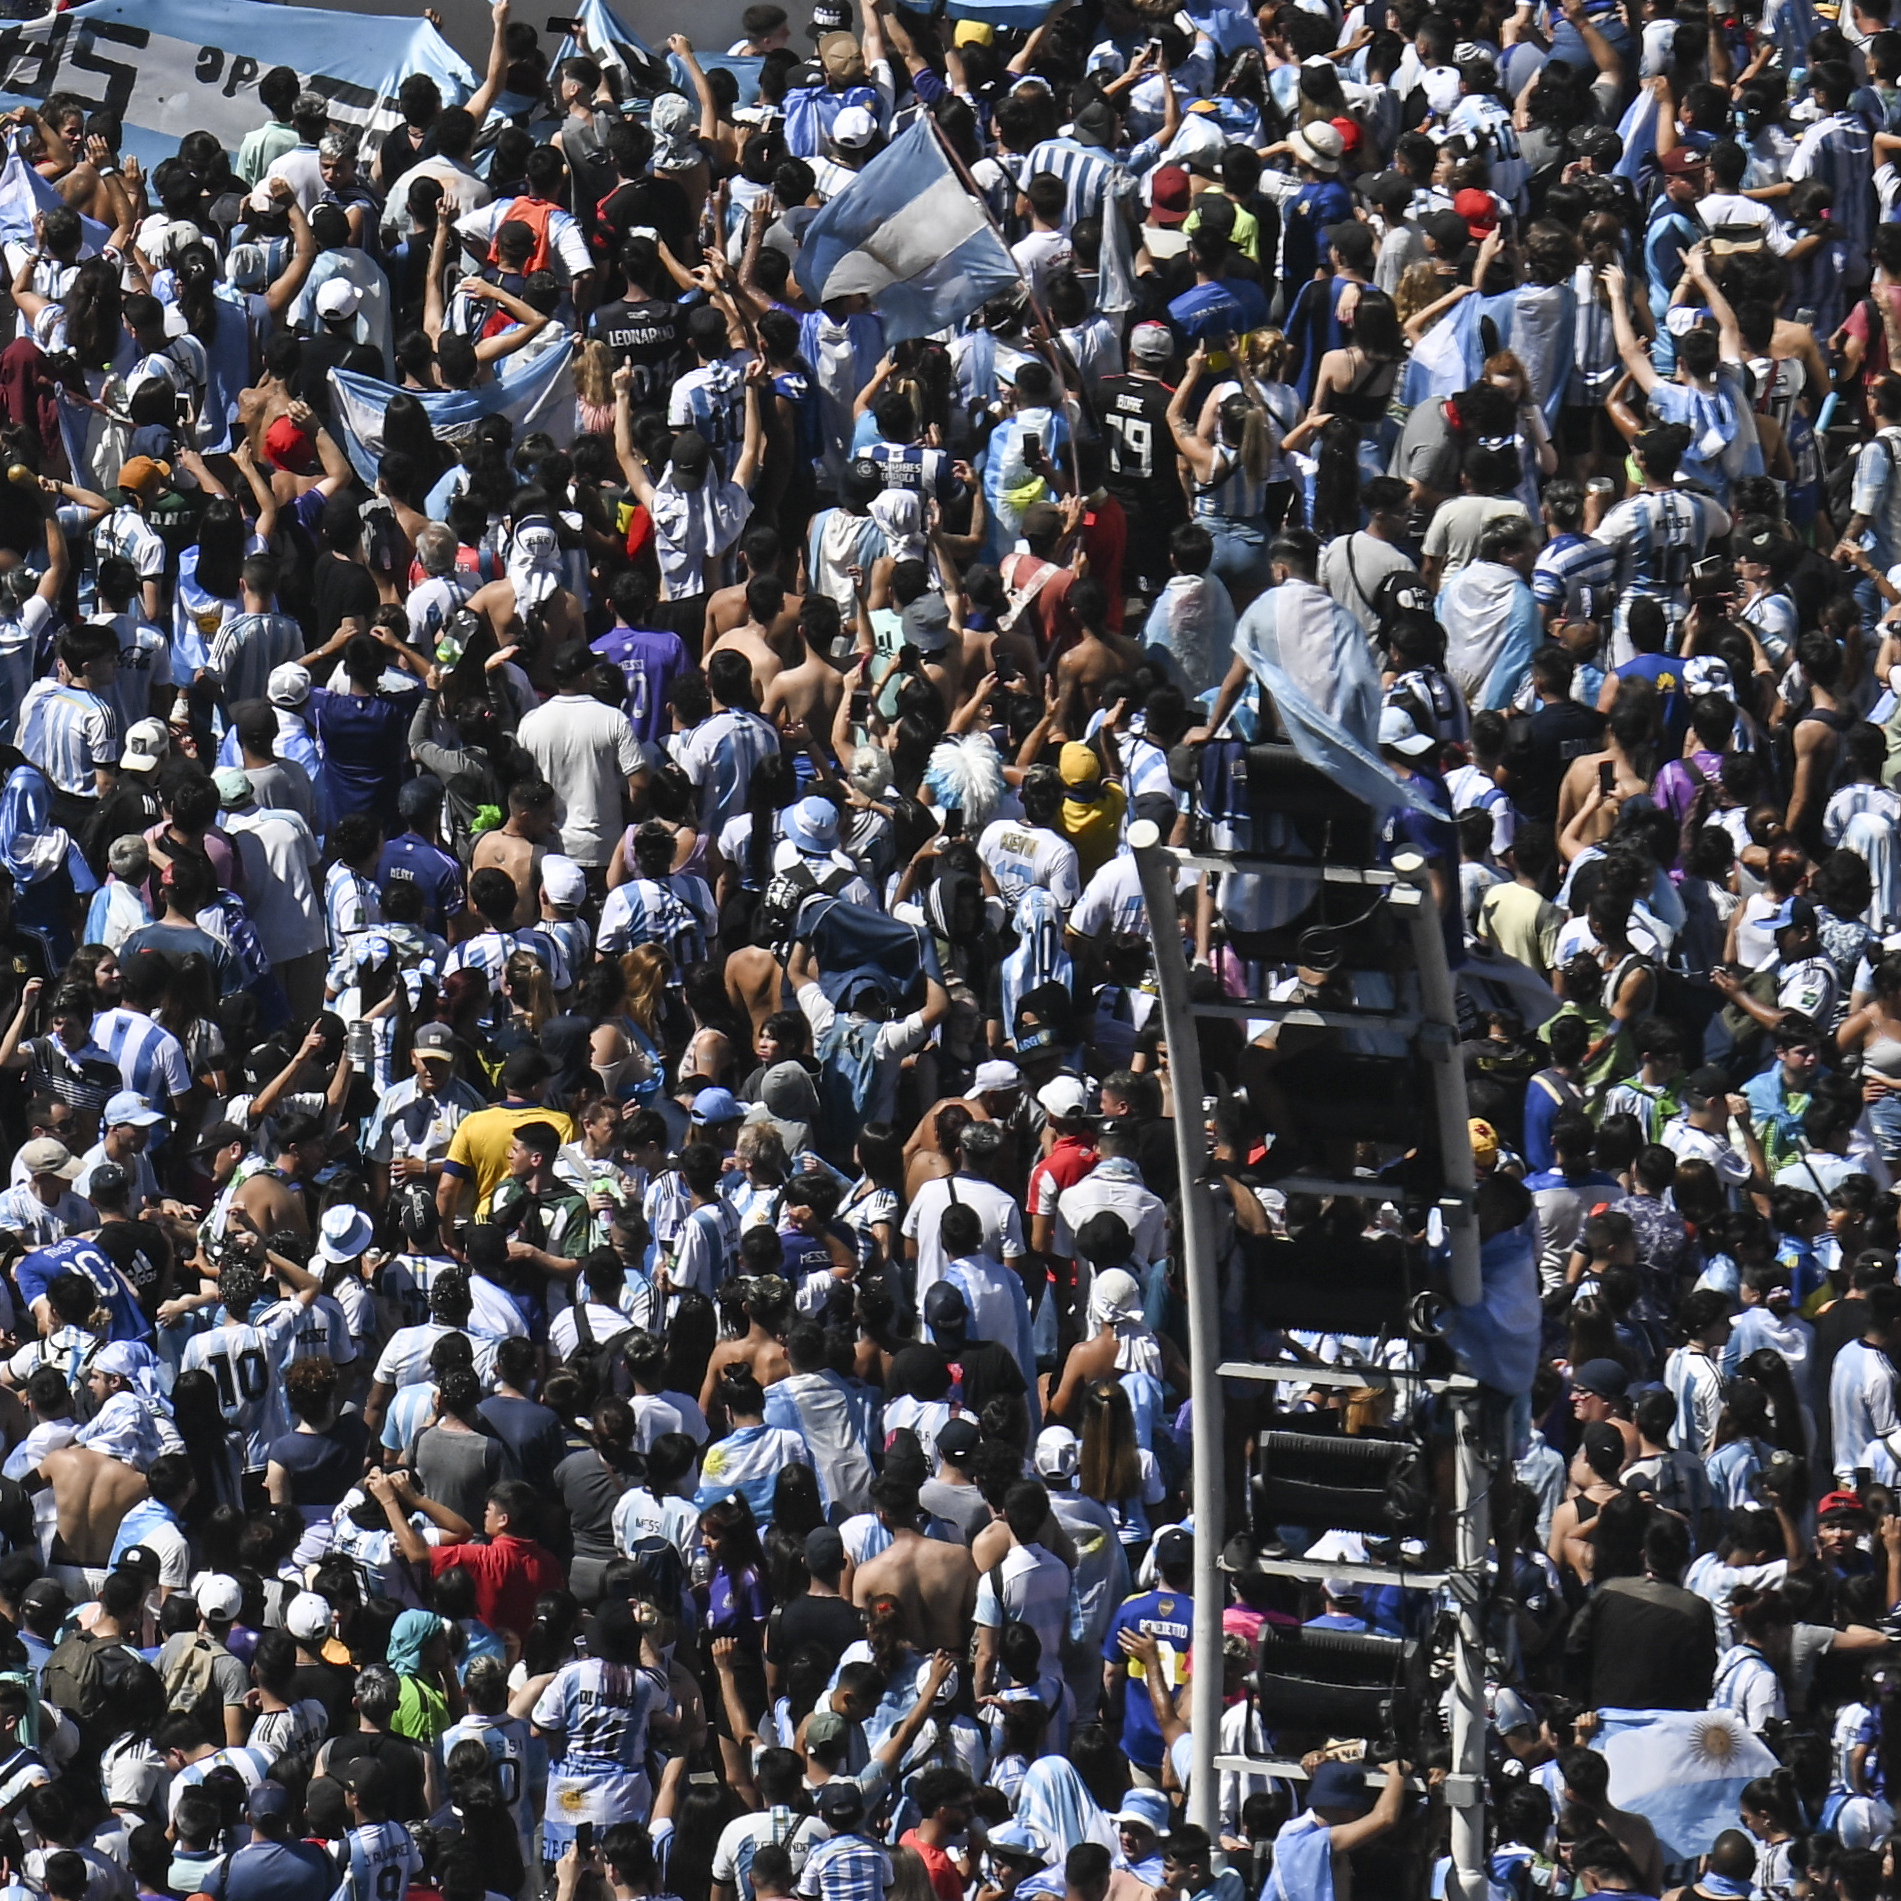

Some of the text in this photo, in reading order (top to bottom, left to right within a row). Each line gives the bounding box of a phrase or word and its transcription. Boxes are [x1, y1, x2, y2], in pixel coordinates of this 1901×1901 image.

[608, 327, 675, 346] LEONARDO
[1105, 413, 1153, 478] 19
[801, 1251, 832, 1265] MESS
[61, 1251, 120, 1297] 10
[297, 1327, 329, 1344] MESSI
[210, 1347, 269, 1408] 10
[635, 1517, 662, 1534] MESSI
[579, 1690, 594, 1706] DI
[488, 1738, 524, 1754] ESSI
